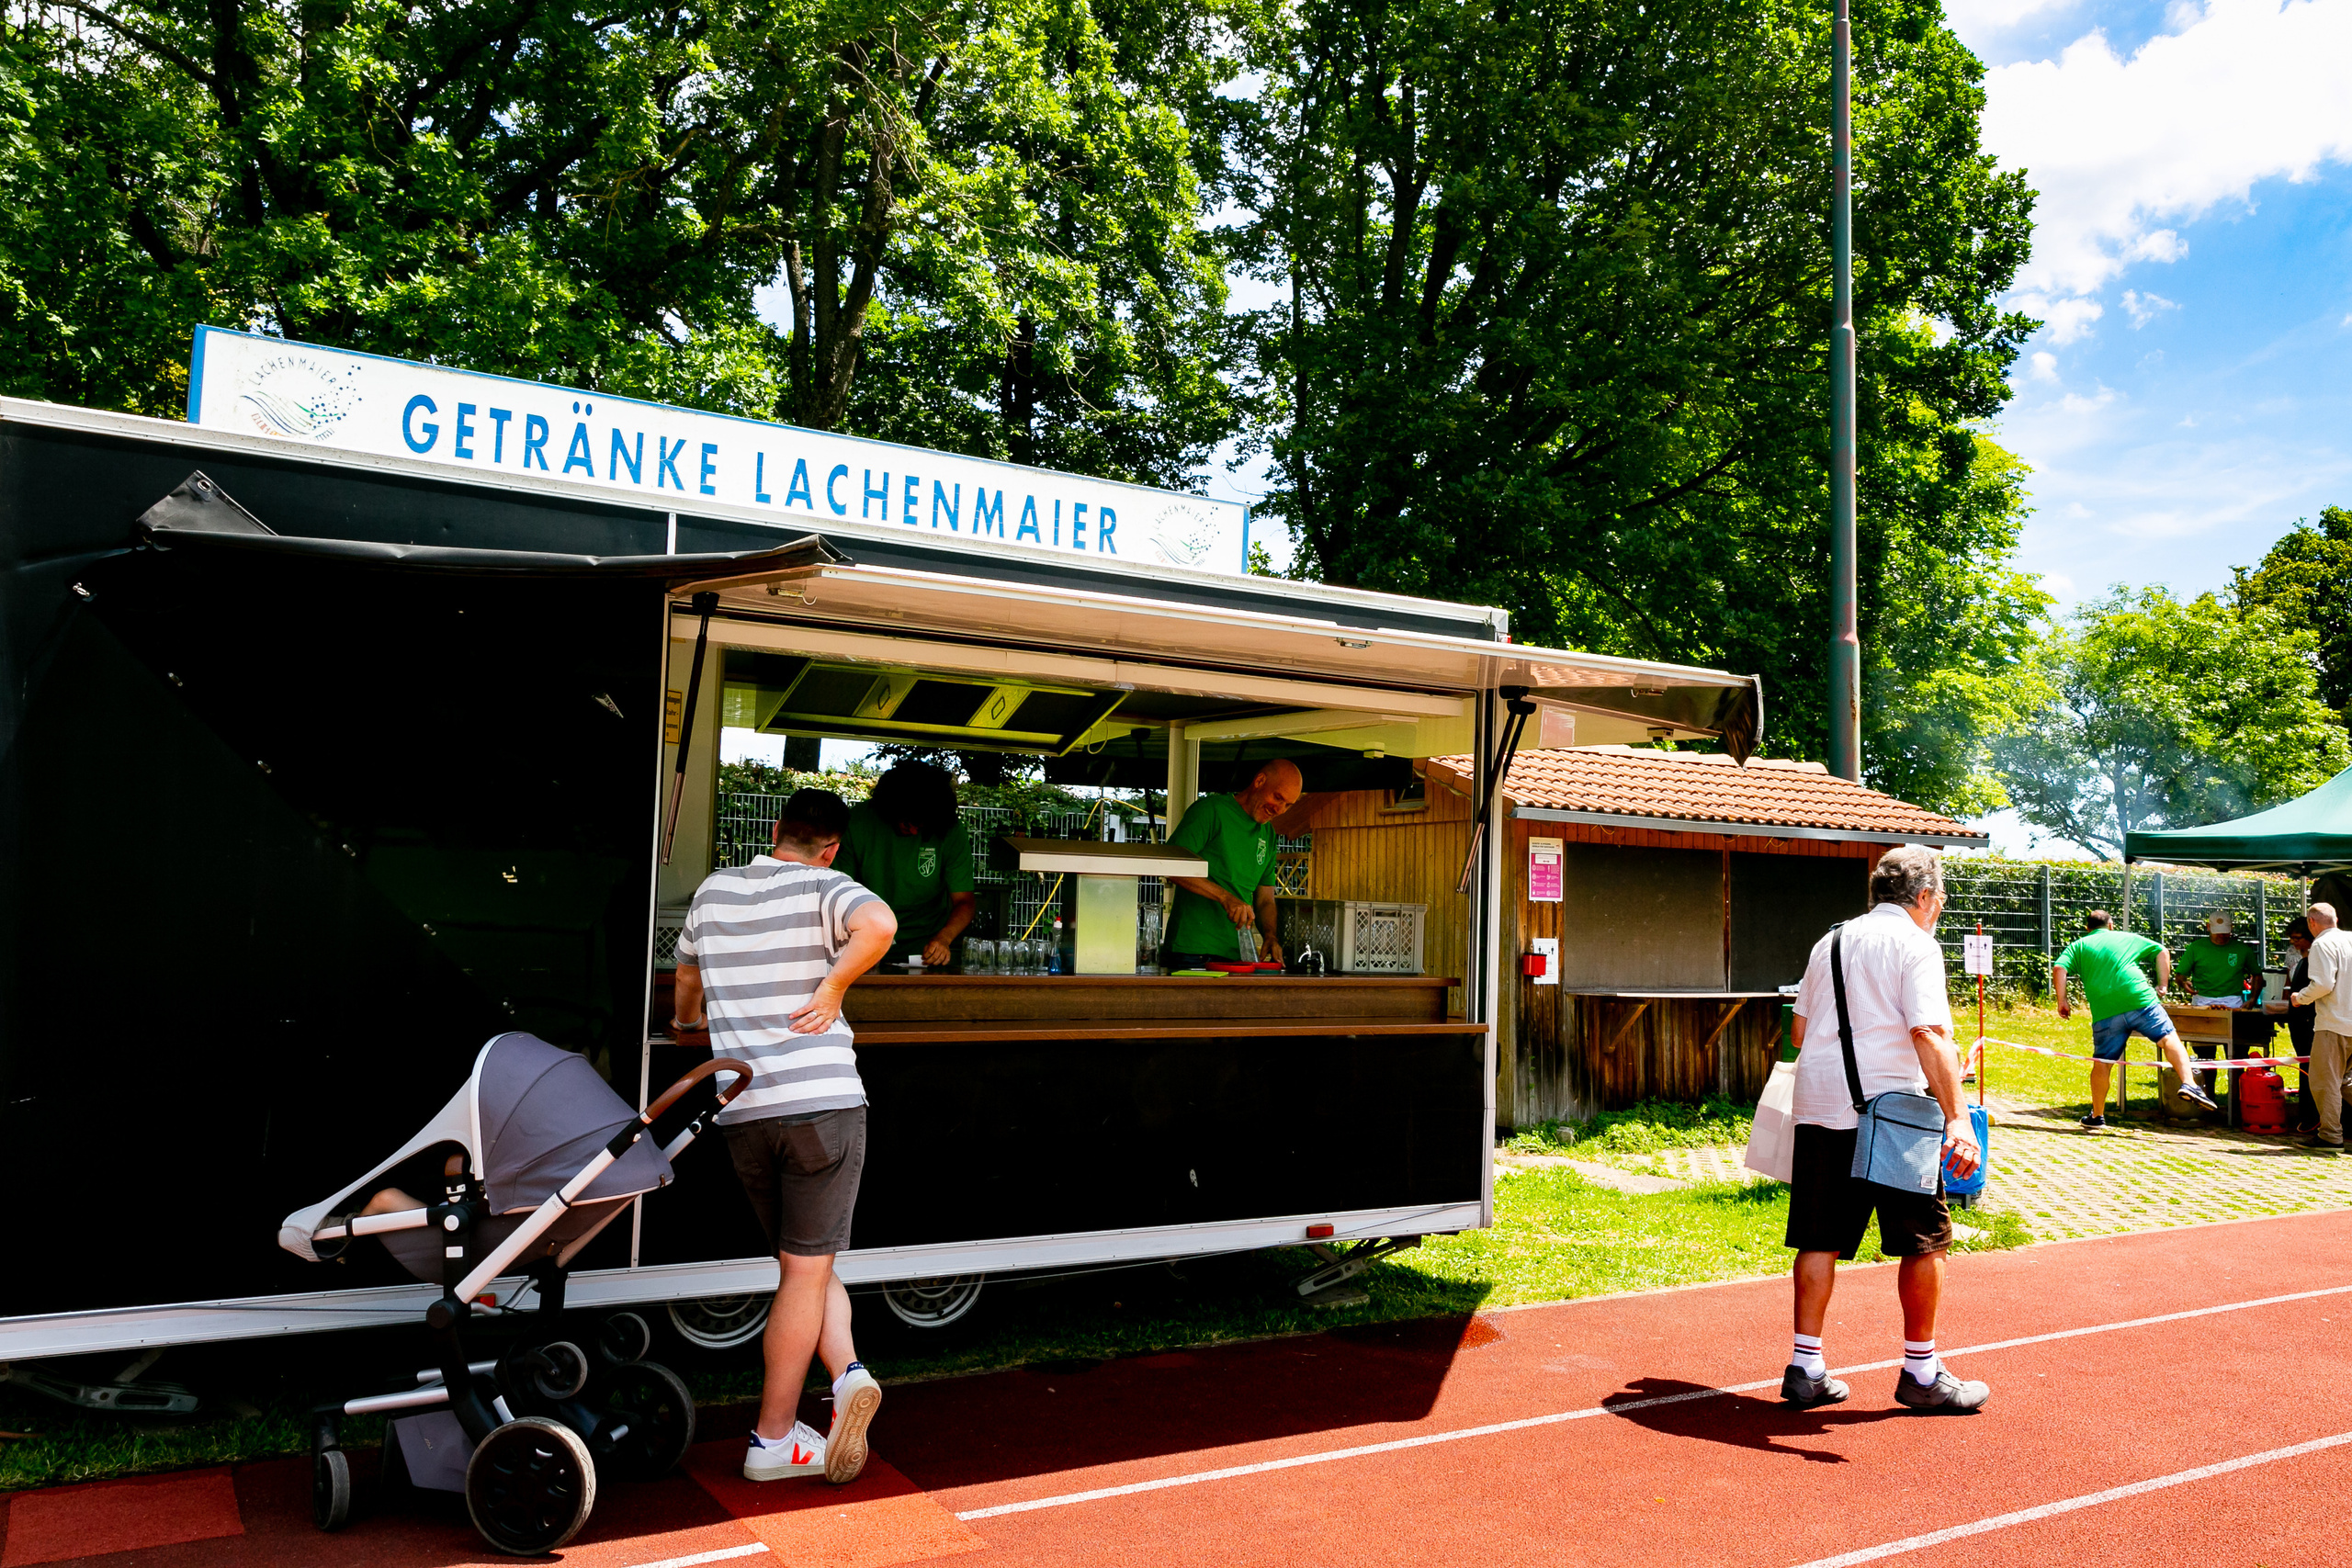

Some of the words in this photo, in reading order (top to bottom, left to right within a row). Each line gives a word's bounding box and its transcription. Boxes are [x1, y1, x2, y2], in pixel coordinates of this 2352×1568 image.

[248, 355, 337, 386] LACHENMAIER
[401, 394, 718, 496] GETRÄNKE
[755, 451, 1117, 555] LACHENMAIER
